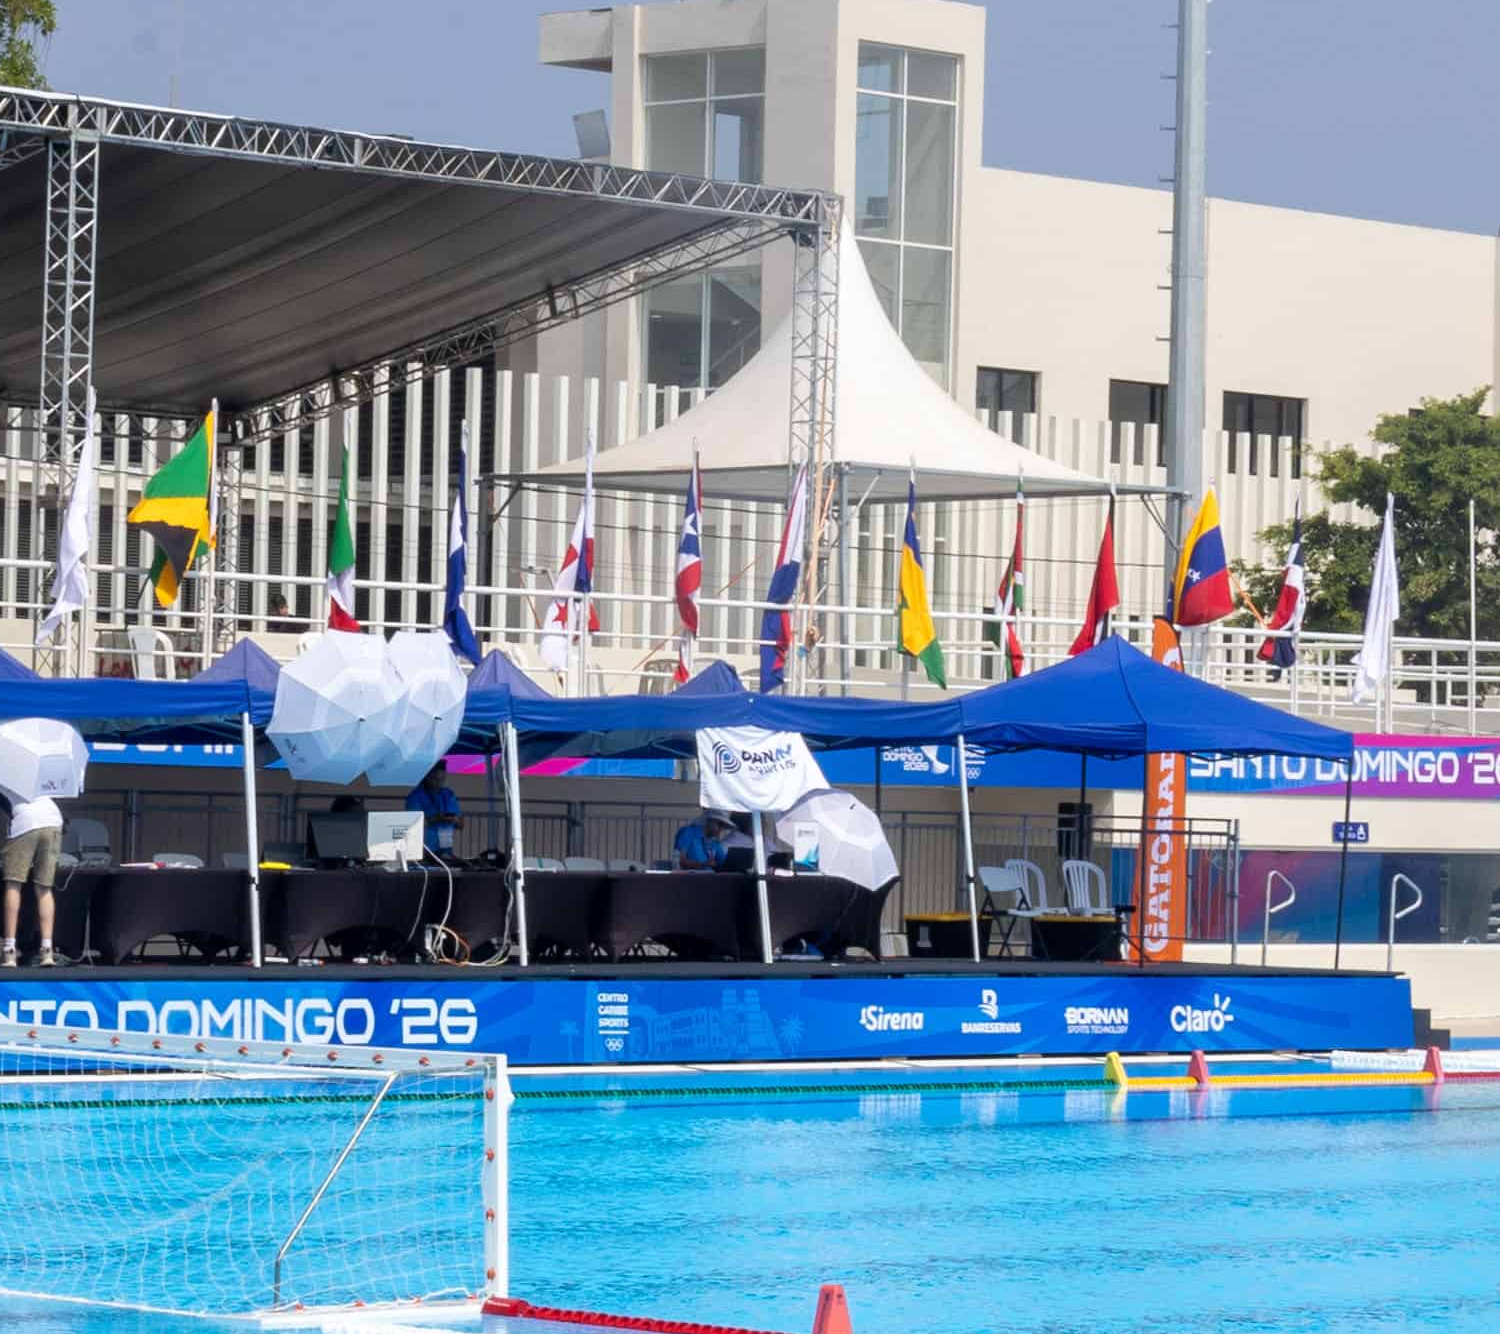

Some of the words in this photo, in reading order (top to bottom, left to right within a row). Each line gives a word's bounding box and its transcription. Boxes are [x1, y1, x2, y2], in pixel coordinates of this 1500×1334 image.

[1144, 753, 1175, 953] GATORAD
[118, 998, 376, 1044] DOMINGO
[865, 1006, 924, 1031] Sirena
[1065, 1007, 1129, 1025] BORNAN
[1170, 1004, 1225, 1032] Claro
